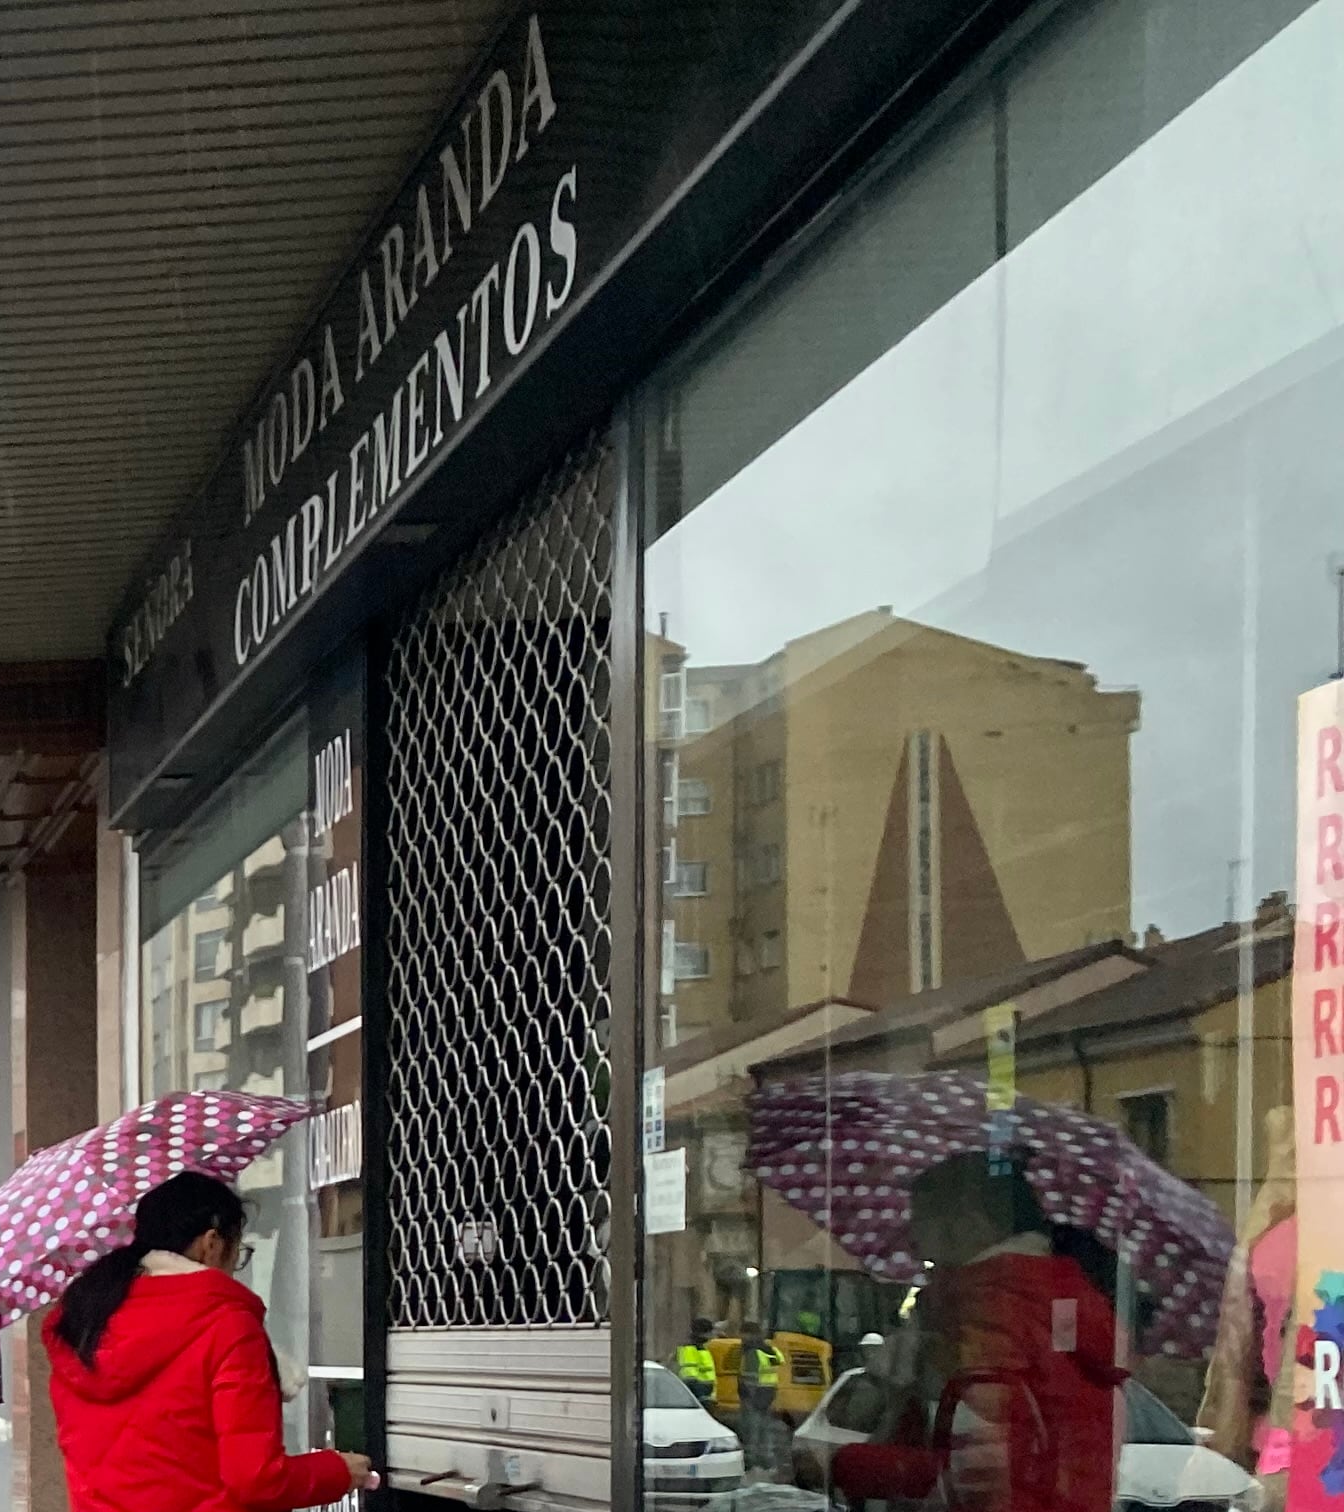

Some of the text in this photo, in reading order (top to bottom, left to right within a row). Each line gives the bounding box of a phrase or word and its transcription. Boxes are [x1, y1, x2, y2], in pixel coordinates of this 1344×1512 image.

[242, 12, 558, 526] MODA ARANDA
[231, 165, 579, 665] COMPLEMENTOS
[314, 728, 354, 838] MODA
[307, 860, 360, 974] ARANDA
[1314, 900, 1344, 971] R
[1313, 987, 1344, 1059] R
